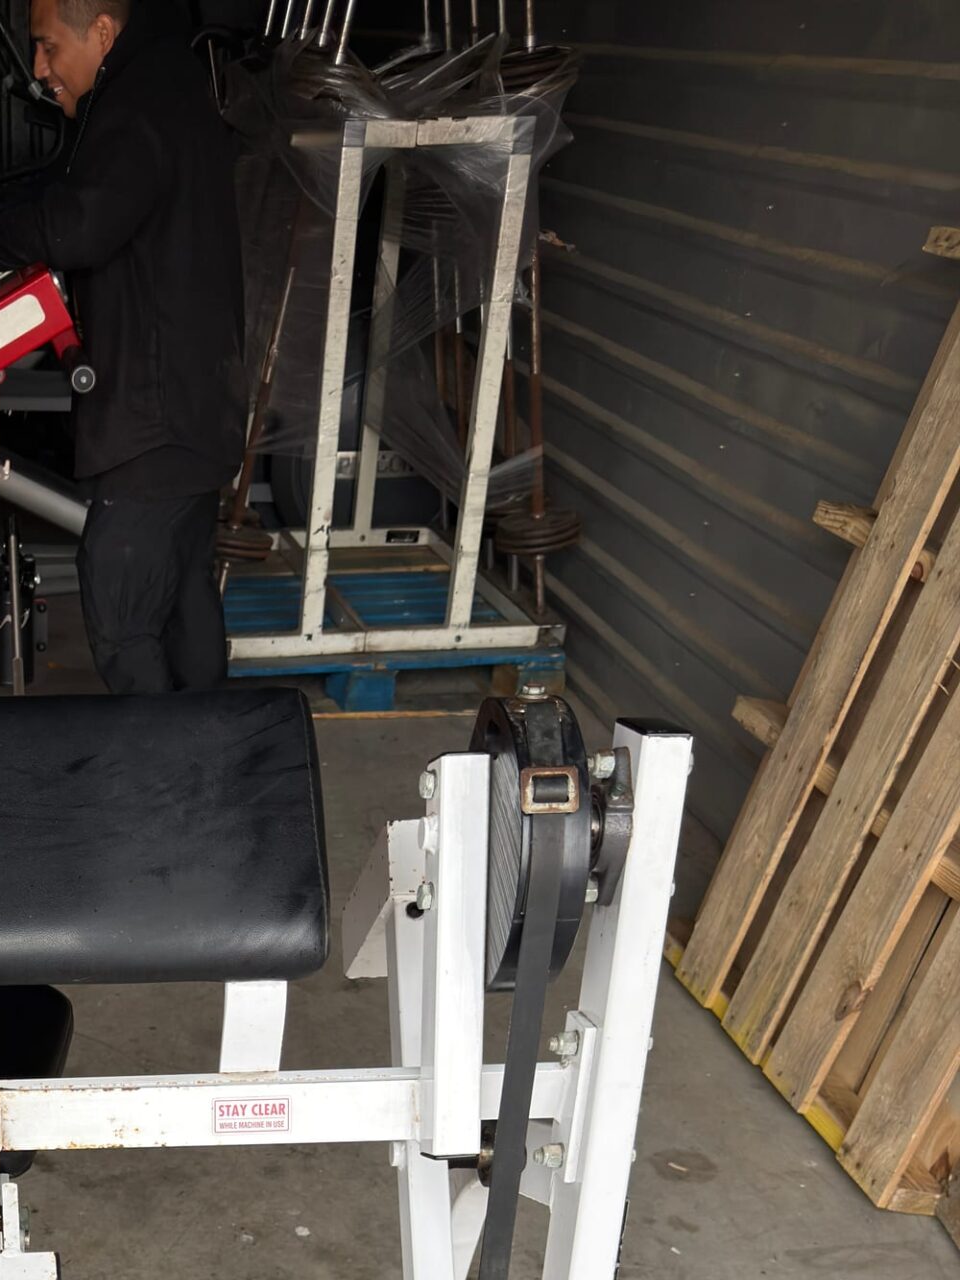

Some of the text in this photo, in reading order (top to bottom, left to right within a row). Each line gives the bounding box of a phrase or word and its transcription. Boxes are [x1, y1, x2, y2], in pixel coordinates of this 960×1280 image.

[218, 1103, 286, 1117] STAY CLEAR
[219, 1120, 284, 1130] WHILE MACHINE IN USE
